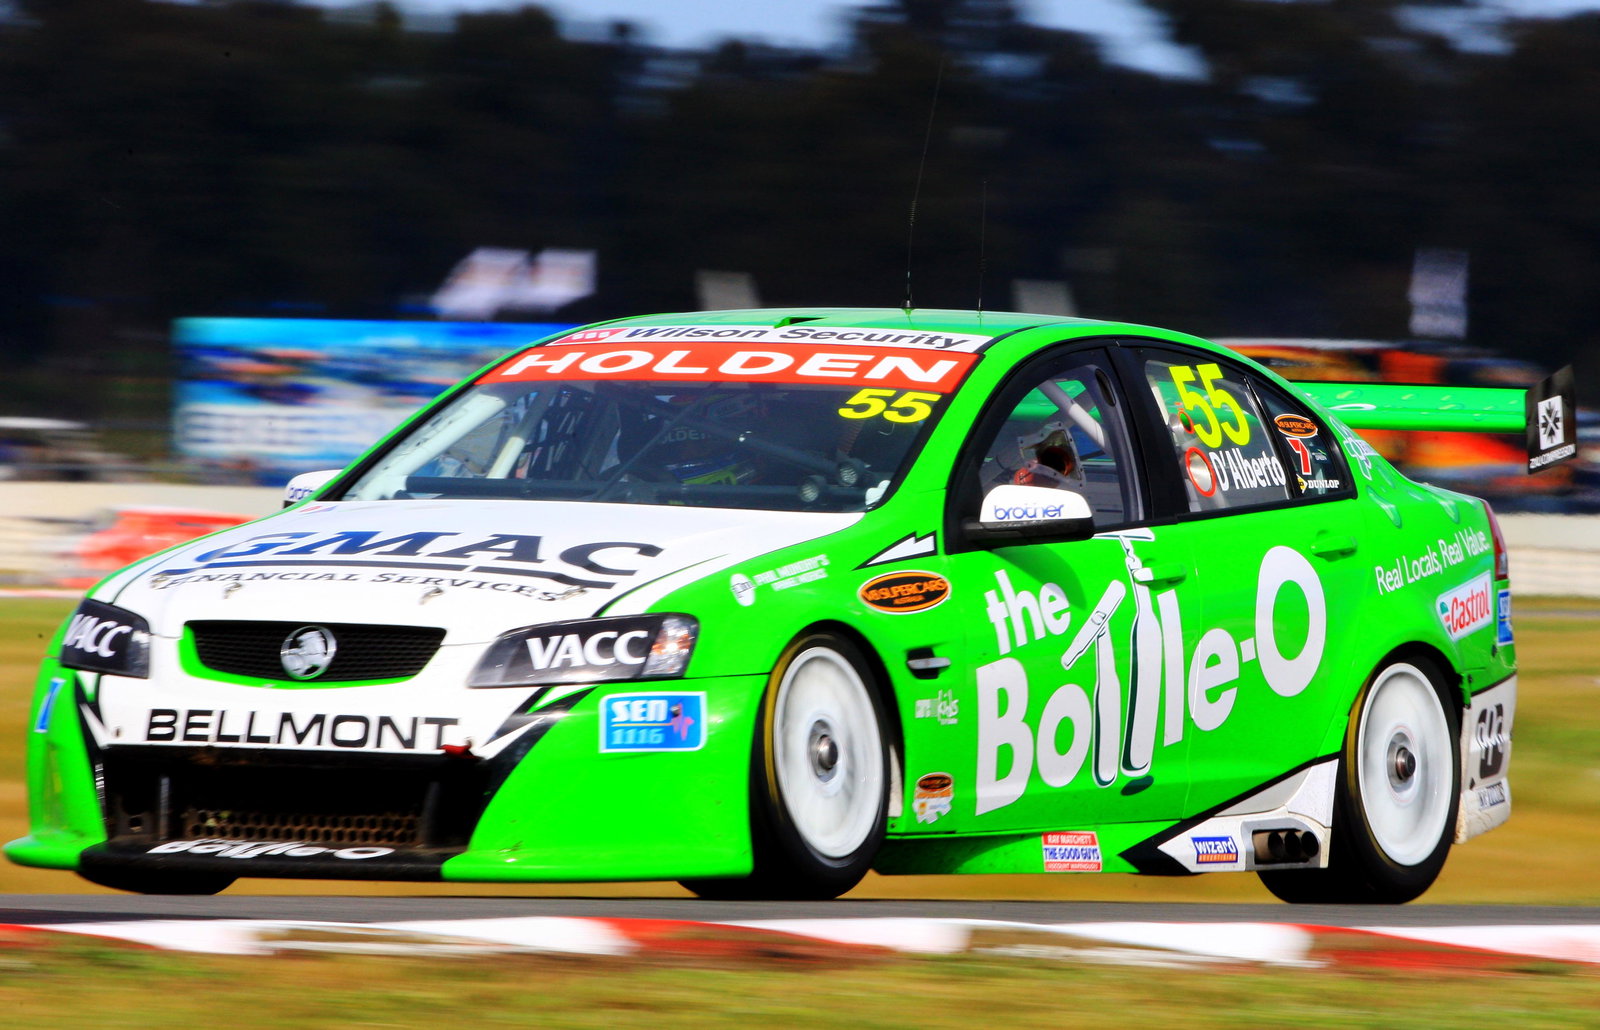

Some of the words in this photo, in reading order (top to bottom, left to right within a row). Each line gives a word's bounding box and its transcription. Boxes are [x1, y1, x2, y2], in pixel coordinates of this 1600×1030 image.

[625, 326, 767, 339] Wilson
[780, 328, 970, 349] Security
[500, 350, 958, 383] HOLDEN
[838, 388, 941, 424] 55
[1169, 363, 1250, 448] 55
[1208, 448, 1286, 492] D'Alberto
[1308, 479, 1340, 489] DUNLOP
[994, 502, 1064, 520] brother
[194, 531, 664, 576] GMAC
[1375, 558, 1404, 595] Real
[1403, 545, 1442, 584] Locals,
[1438, 532, 1465, 568] Real
[1459, 526, 1490, 557] Value.
[160, 572, 362, 590] FINANCIAL
[377, 572, 558, 602] SERVICES
[984, 569, 1071, 656] the
[1451, 581, 1490, 633] Castrol
[62, 613, 132, 657] VACC
[526, 630, 648, 670] VACC
[146, 709, 460, 749] BELLMONT
[611, 699, 668, 723] SEN
[611, 729, 665, 745] 1116
[1044, 848, 1058, 860] THE
[1058, 848, 1081, 860] GOOD
[1080, 848, 1100, 860] GUYS
[1194, 837, 1237, 854] wizard
